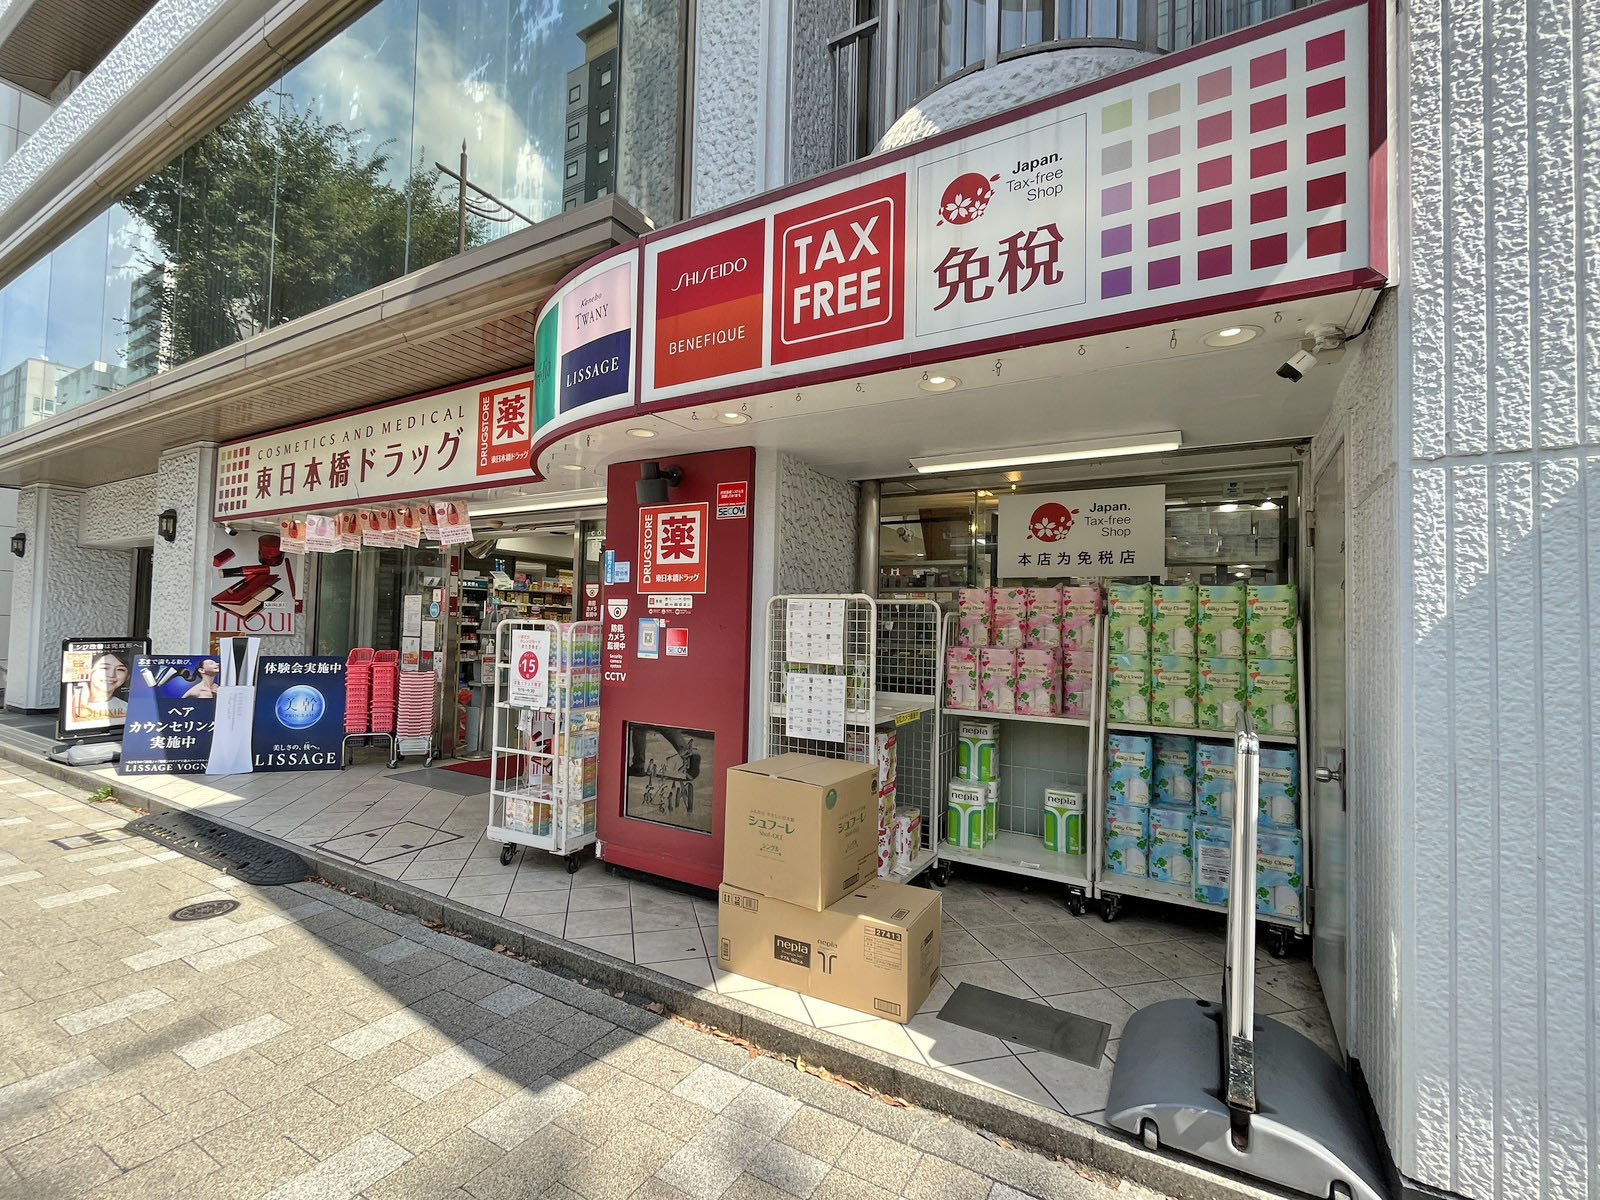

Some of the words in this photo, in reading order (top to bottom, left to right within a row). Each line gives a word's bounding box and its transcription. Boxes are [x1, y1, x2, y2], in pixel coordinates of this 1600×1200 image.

[1012, 150, 1064, 175] Japan.
[1006, 167, 1064, 193] Tax-free
[1027, 182, 1064, 202] Shop
[794, 215, 880, 275] TAX
[671, 257, 748, 292] SHISEIDO
[580, 291, 602, 309] Kanebo
[793, 266, 881, 325] FREE
[575, 304, 609, 330] TWANY
[669, 325, 746, 356] BENEFIQUE
[566, 356, 619, 388] LISSAGE
[496, 394, 526, 440] 薬
[258, 433, 336, 460] COSMETICS
[343, 425, 374, 443] AND
[381, 405, 465, 435] MEDICAL
[480, 396, 490, 467] DRUGSTORE
[255, 426, 464, 500] 東日本橋ドラッグ
[718, 506, 745, 516] SECOM
[1089, 501, 1131, 515] Japan.
[1084, 514, 1131, 527] Tax-free
[660, 515, 696, 560] 薬
[1101, 525, 1131, 539] Shop
[643, 514, 653, 584] DRUGSTORE
[1017, 550, 1136, 567] 本店为免税店
[611, 624, 624, 633] 防犯
[608, 633, 625, 641] カメラ
[607, 642, 626, 651] 監視中
[264, 662, 342, 675] 体験会実施中
[521, 659, 536, 673] 15
[604, 671, 627, 682] CCTV
[168, 706, 195, 718] ヘア
[962, 726, 989, 736] nepia
[150, 736, 196, 750] 実施中
[255, 752, 337, 767] LISSAGE
[125, 763, 173, 773] LISSAGE
[177, 763, 208, 772] VOGN
[951, 792, 979, 802] nepia
[1047, 794, 1077, 807] nepia
[749, 815, 796, 834] シュフーレ
[876, 929, 901, 941] 27413
[777, 939, 809, 955] nepia
[817, 939, 838, 949] nepia
